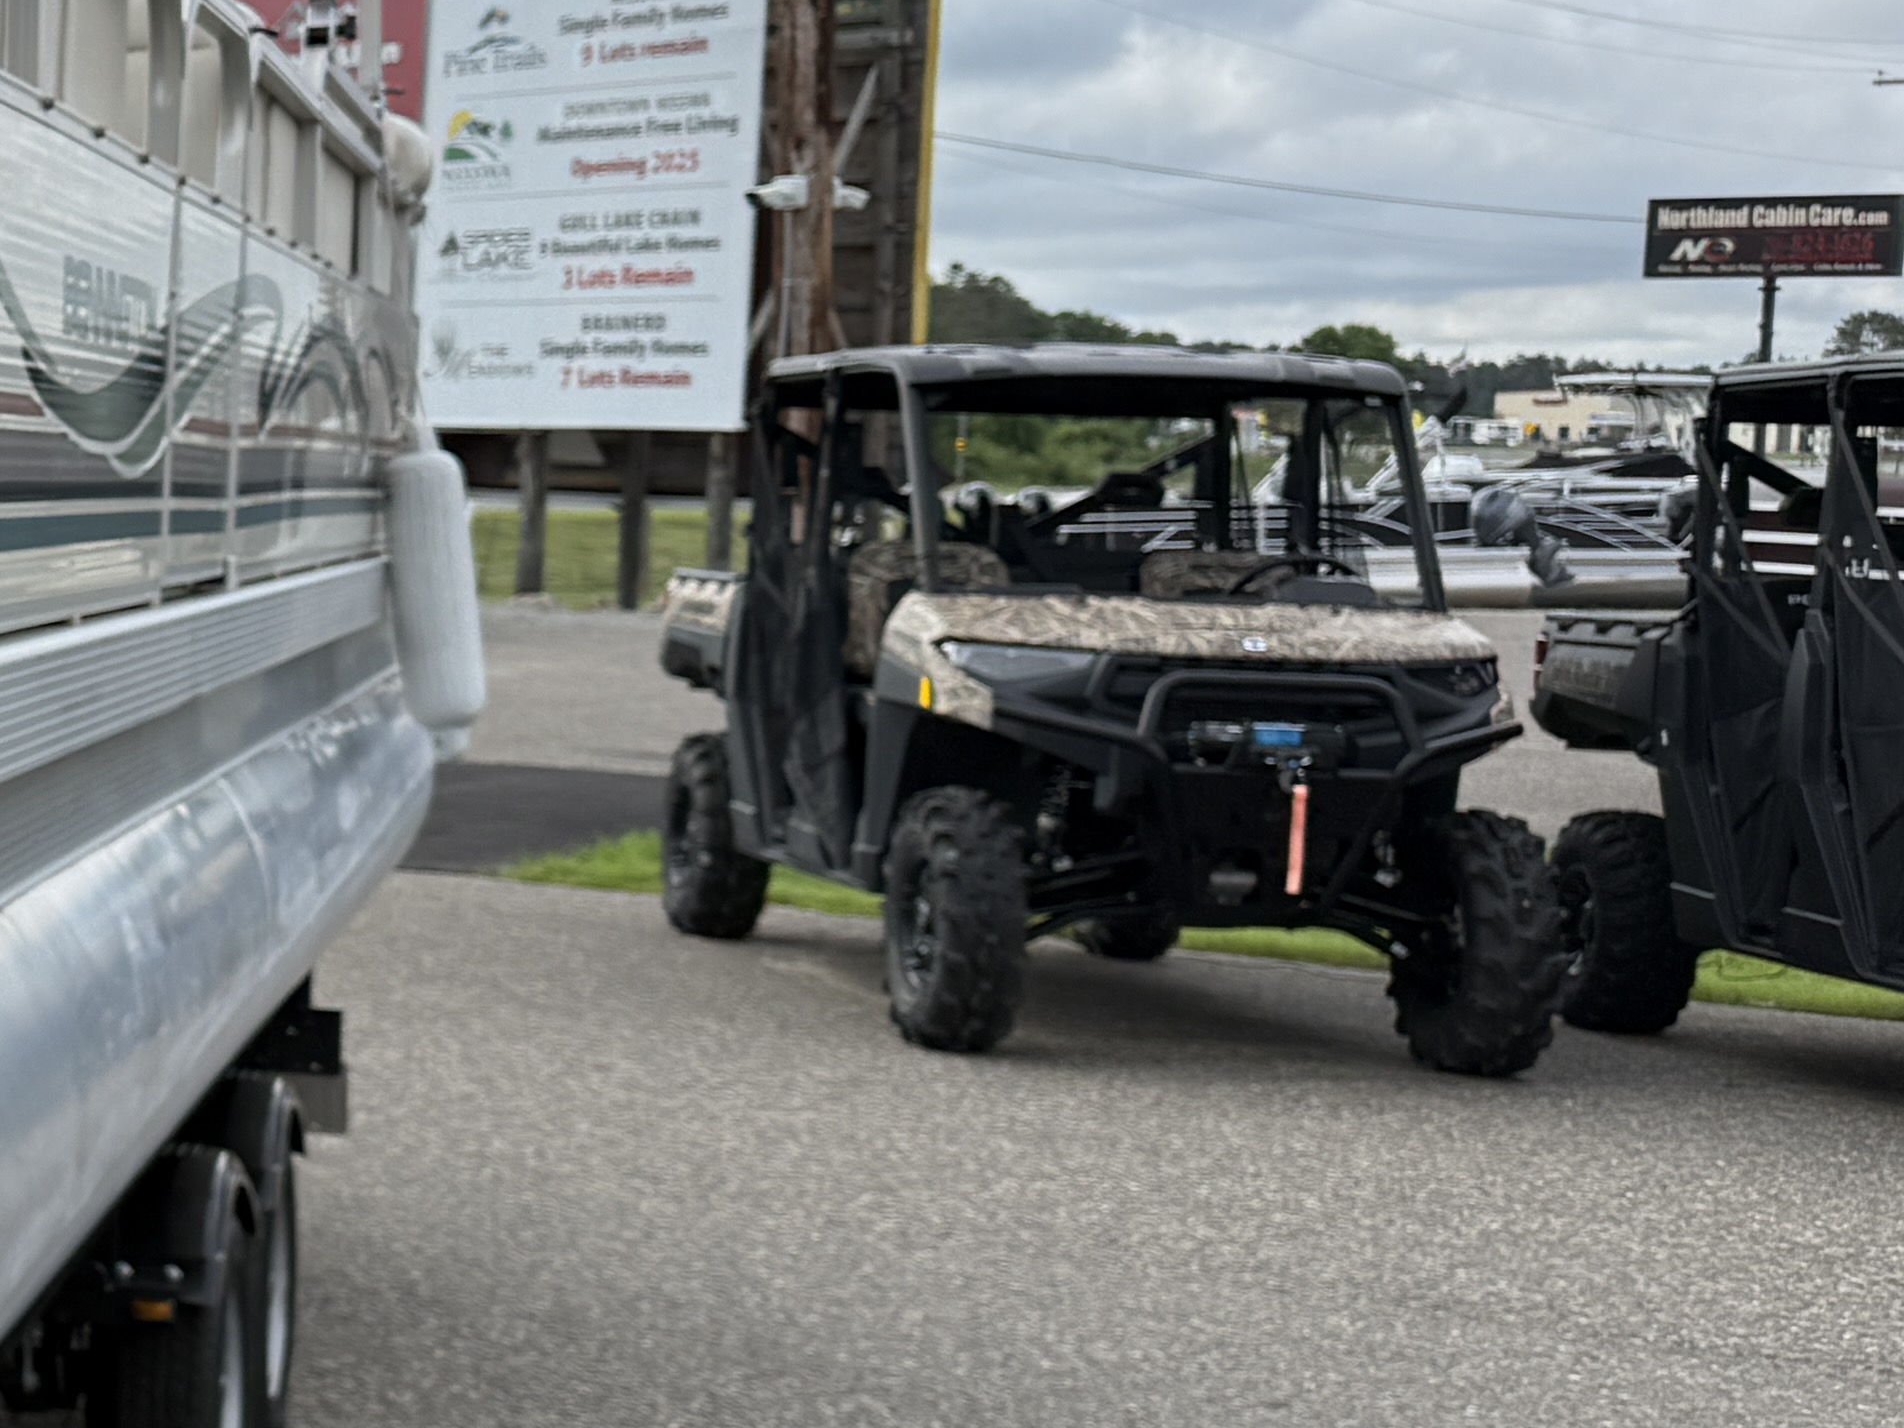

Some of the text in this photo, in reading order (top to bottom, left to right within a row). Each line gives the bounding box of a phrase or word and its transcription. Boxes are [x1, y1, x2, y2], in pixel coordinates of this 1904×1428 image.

[559, 2, 730, 37] Single Family Homes
[443, 49, 489, 79] Pine
[599, 39, 636, 64] Lots
[647, 116, 683, 136] Free
[686, 113, 740, 137] Living
[570, 154, 647, 180] Opening
[602, 211, 644, 230] LAKE
[1658, 202, 1889, 230] Northland Cabin Care.com
[625, 237, 663, 256] Lake
[666, 234, 722, 253] Homes
[577, 266, 616, 290] Lots
[620, 262, 695, 287] Remain
[540, 336, 709, 361] Single Family Homes
[576, 366, 616, 389] Lots
[619, 365, 693, 389] Remain
